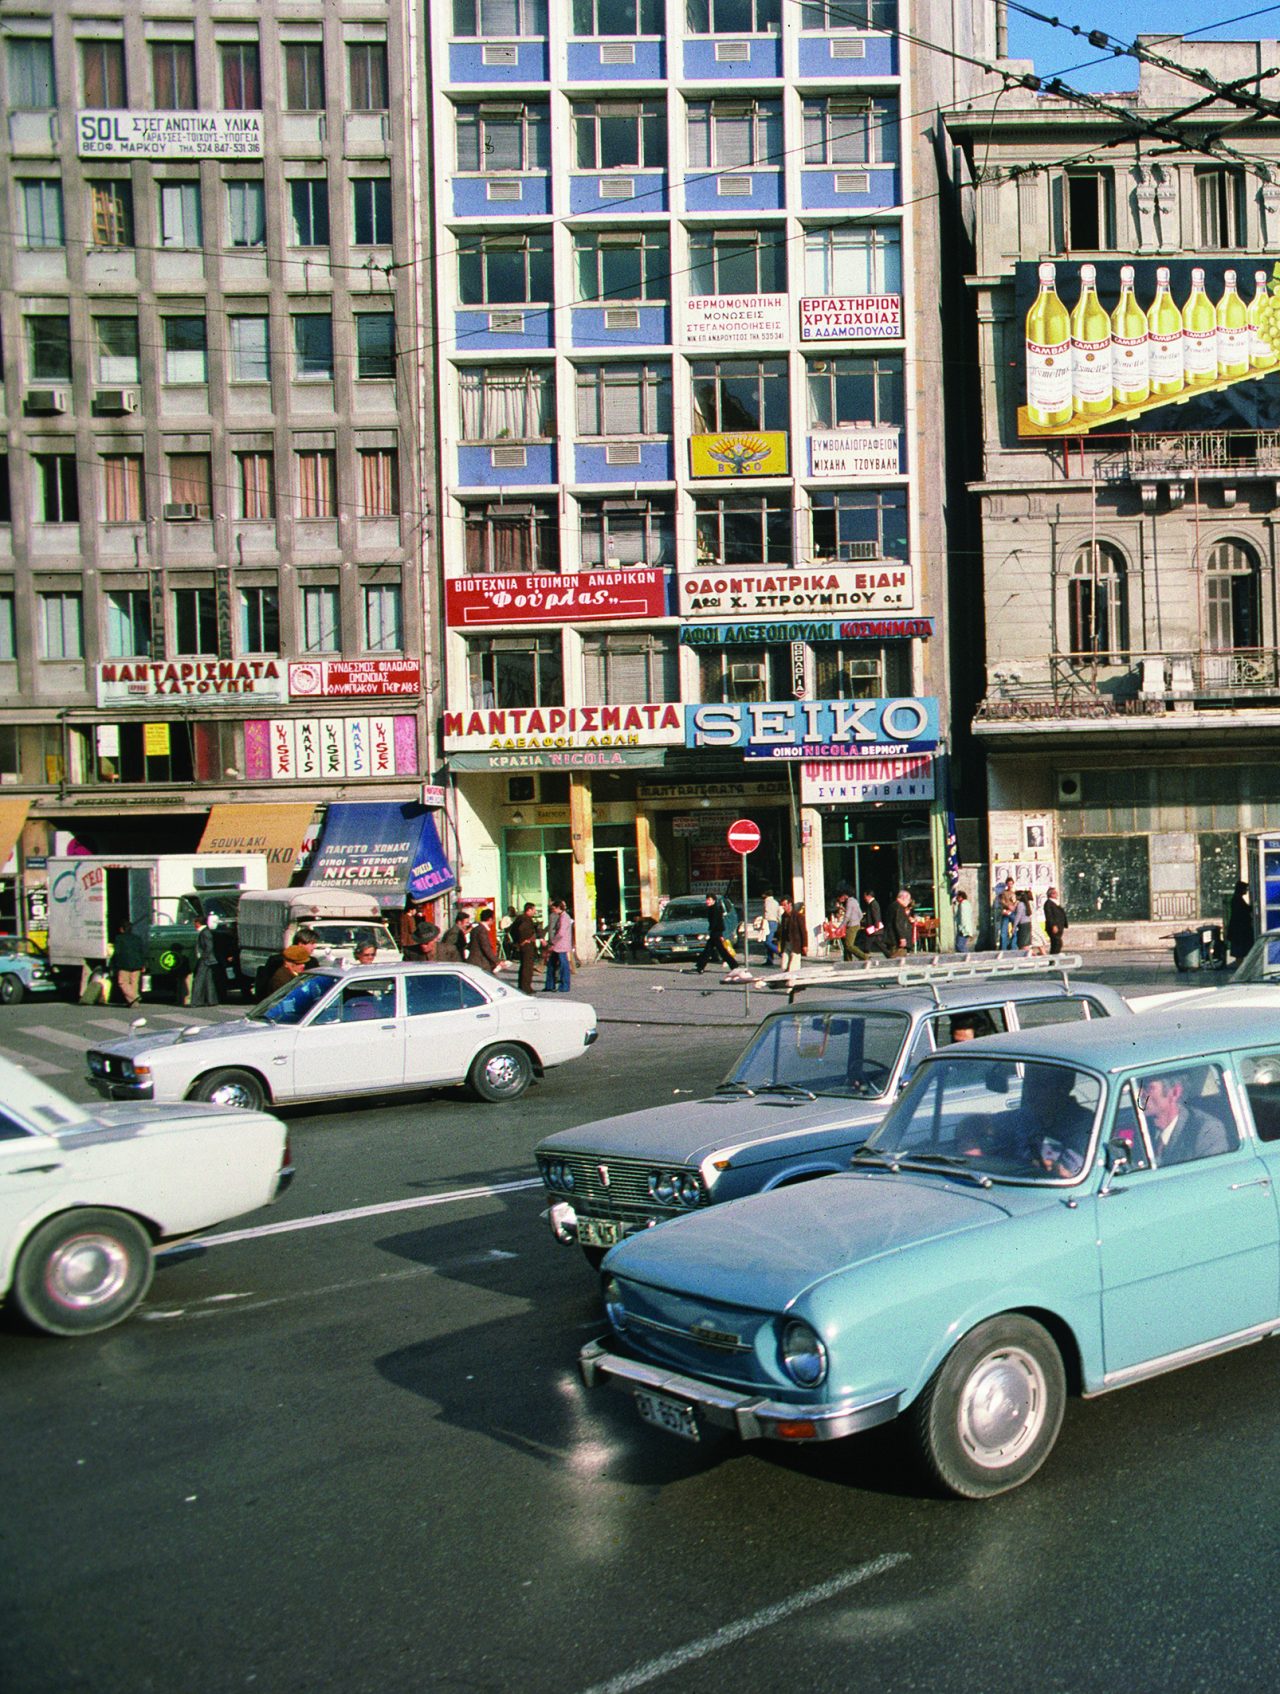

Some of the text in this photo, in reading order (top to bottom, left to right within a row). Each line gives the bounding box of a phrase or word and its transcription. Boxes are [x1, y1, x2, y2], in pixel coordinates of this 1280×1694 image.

[81, 116, 129, 141] SOL
[132, 118, 260, 131] ΣΤΕΓΑΝΩΤΙΚΑ ΥΛΙΚΑ
[120, 142, 166, 152] ΜΑΡΚΟΥ
[688, 298, 782, 310] ΘΕΡΜΟΜΟΝΩΤΙΚΗ
[803, 298, 899, 311] ΕΡΓΑΣΤΗΡΙΟΝ
[704, 311, 764, 320] ΜΟΝΩΣΕΙΣ
[804, 312, 899, 325] ΧΡΥΣΩΧΟΙΑΣ
[687, 321, 781, 332] ΣΤΕΓΑΝΟΠΟΙΗΣΕΙΣ
[815, 326, 900, 337] ΑΔΑΜΟΠΟΥΛΟΣ
[1114, 336, 1145, 346] CAMBAS
[1151, 332, 1180, 342] CAMBAS
[1030, 344, 1068, 355] CAMBAS
[1074, 340, 1109, 350] CAMBAS
[814, 459, 846, 470] ΜΙΧΑΗΛ
[455, 572, 656, 592] ΒΙΟΤΕΧΝΙΑ ΕΤΟΙΜΩΝ ΑΝΔΡΙΚΩΝ
[685, 572, 906, 595] ΟΔΟΝΤΙΑΤΡΙΚΑ ΕΙΔΗ
[755, 592, 875, 607] ΣΤΡΟΥΜΠΟΥ
[682, 619, 933, 643] ΑΦΟΙ ΑΛΕΞΟΠΟΥΛΟΙ ΚΟΣΜΗΜΑΤΑ
[102, 661, 279, 682] ΜΑΝΤΑΡΙΣΜΑΤΑ
[328, 662, 375, 673] ΣΥΝΔΕΣΜΟΣ
[349, 672, 389, 683] ΟΜΟΝΟΙΑΣ
[154, 680, 254, 694] ΧΑΤΟΥΠΗ
[444, 704, 681, 737] ΜΑΝΤΑΡΙΣΜΑΤΑ
[693, 699, 928, 746] SEIKO
[352, 721, 364, 771] MAKIS
[489, 733, 640, 749] ΑΔΕΛΦΟΙ ΛΩΛΗ
[302, 724, 315, 773] MAKIS
[773, 746, 802, 757] ΟΙΝΟΙ
[861, 743, 909, 756] ΒΕΡΜΟΥΤ
[489, 755, 543, 768] ΚΡΑΣΙΑ
[804, 756, 933, 782] ΨΗΤΟΠΩΛΕΙΟΝ
[818, 785, 926, 798] ΣΥΝΤΡΙΒΑΝΙ
[210, 836, 267, 849] SOUVLAKI
[319, 856, 409, 867] ΟΙΝΟΙ VERMOUTH
[324, 865, 396, 879] NICOLA
